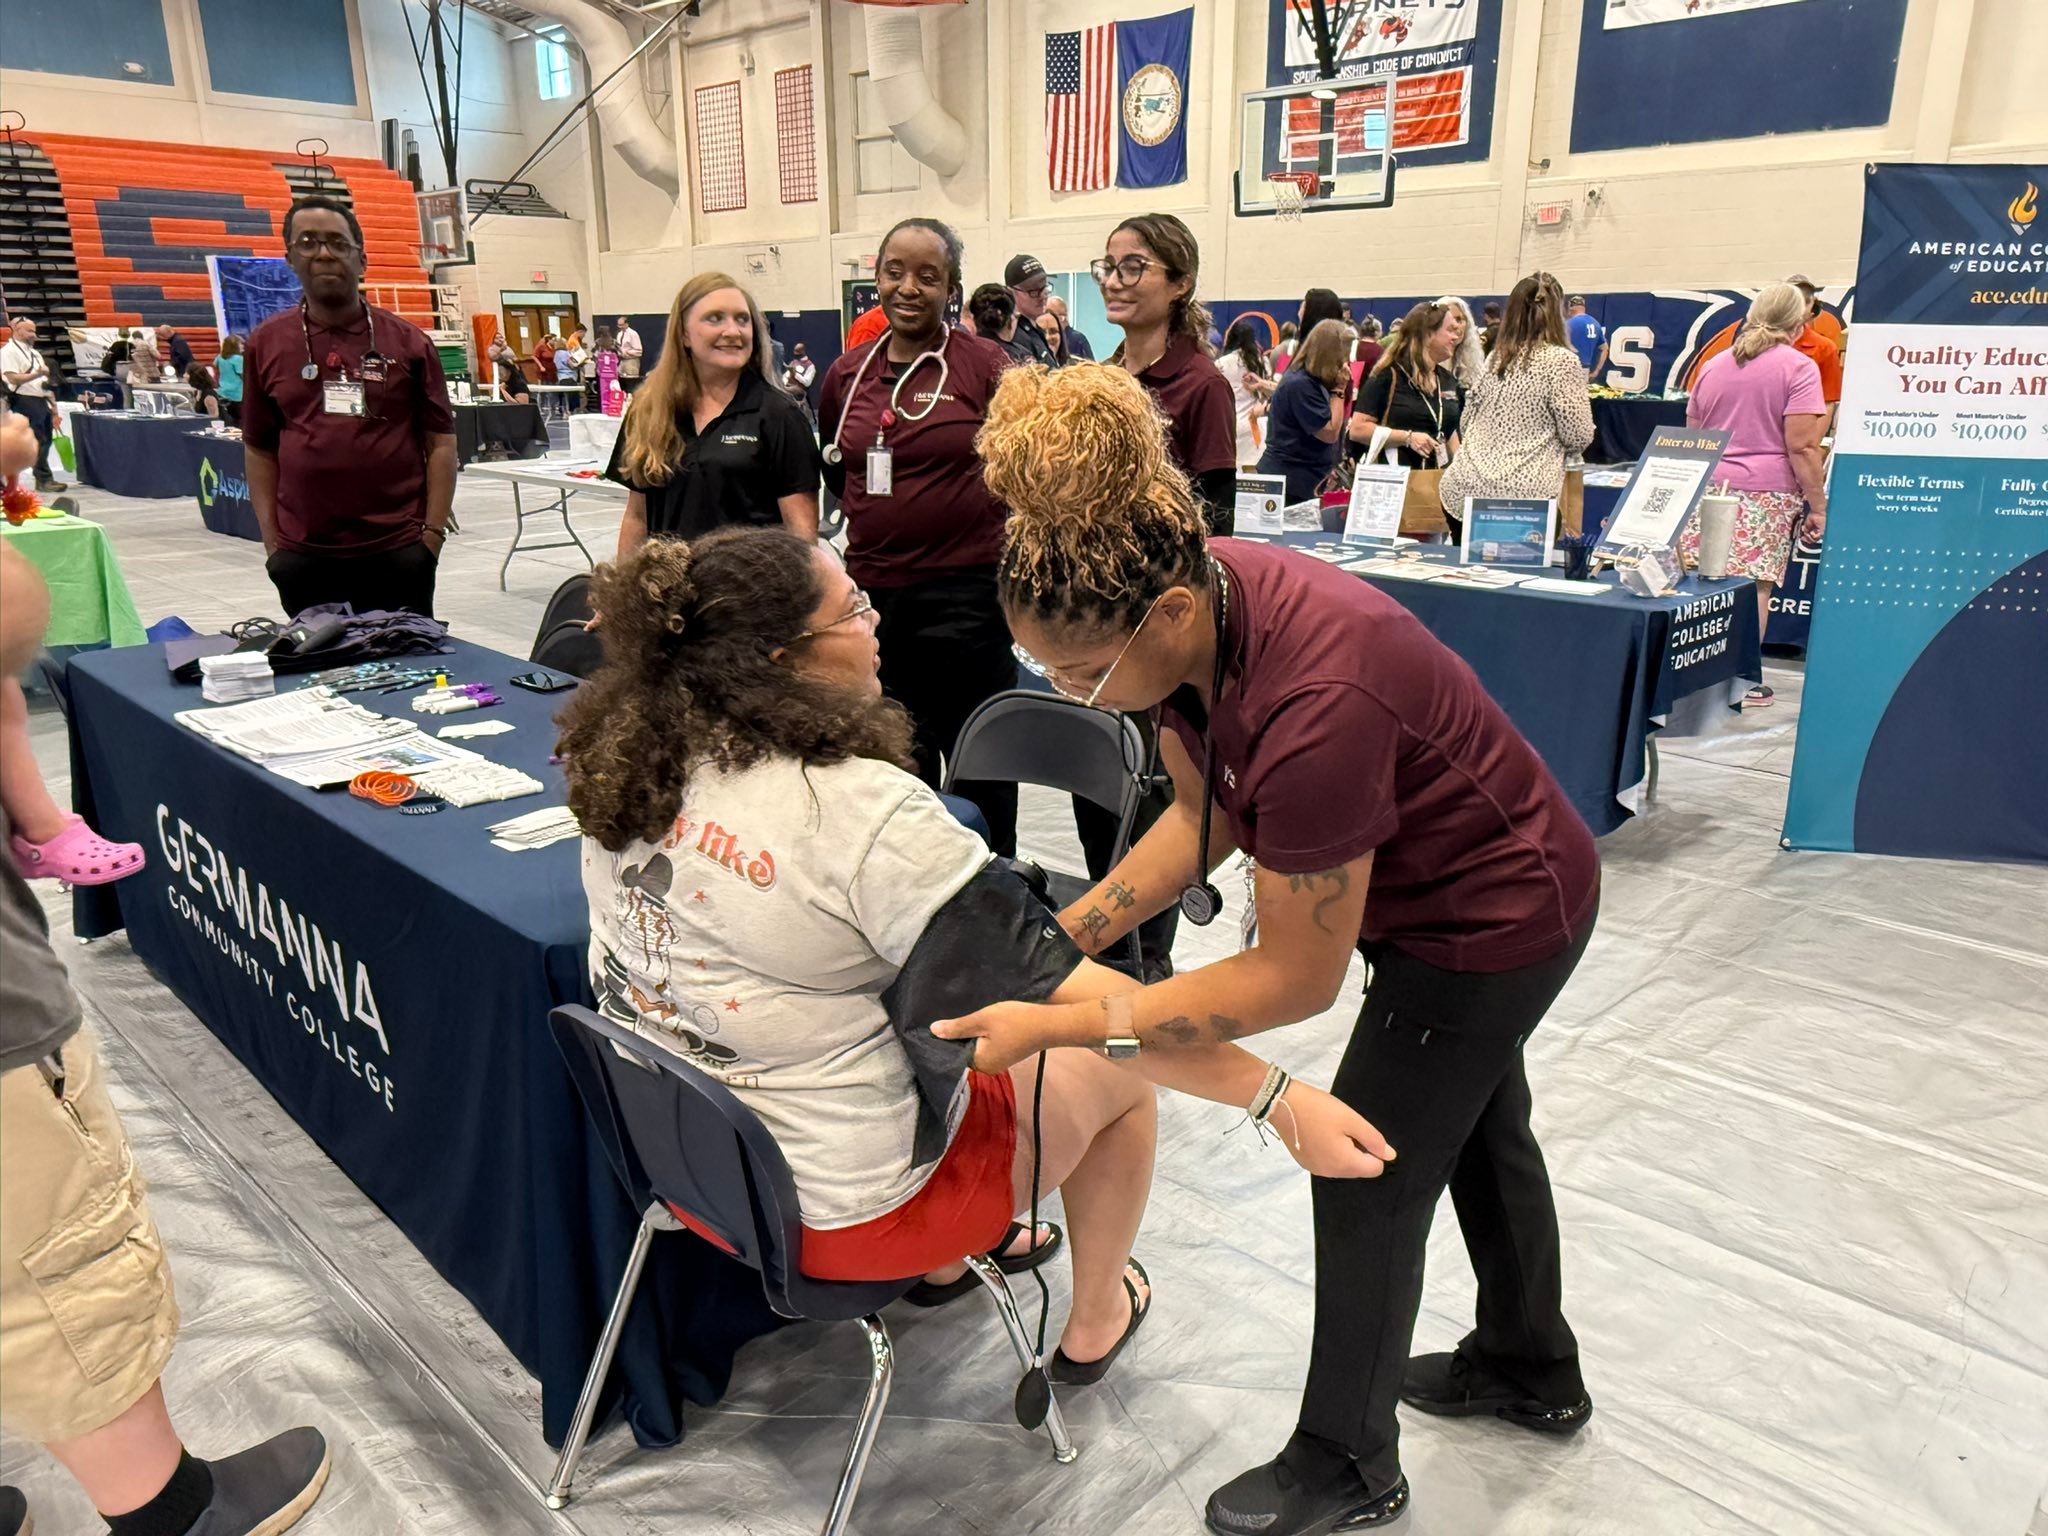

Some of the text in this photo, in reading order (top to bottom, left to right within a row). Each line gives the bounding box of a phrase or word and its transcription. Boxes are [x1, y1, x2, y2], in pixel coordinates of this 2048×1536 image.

[1372, 56, 1399, 75] CODE
[1400, 55, 1413, 70] OF
[1415, 47, 1464, 68] CONDUCT
[1909, 241, 2048, 256] AMERICAN C
[1949, 260, 1965, 273] of
[1970, 286, 2048, 304] ace.edu
[1887, 345, 2048, 371] Quality Educ
[1899, 375, 1947, 394] You
[1954, 375, 2002, 395] Can
[1862, 420, 1937, 439] $10,000
[1951, 422, 2027, 442] $10,000
[1655, 435, 1722, 451] Enter to Win!
[1857, 474, 1965, 490] Flexible Terms
[2001, 478, 2038, 495] Fully
[1875, 492, 1942, 503] New term start
[1875, 504, 1900, 514] every
[1910, 504, 1938, 513] weeks
[1994, 507, 2045, 516] Certificate
[1674, 591, 1735, 624] AMERICAN
[1671, 616, 1724, 648] COLLEGE
[695, 821, 777, 893] like
[156, 802, 390, 1056] GERMANNA
[167, 884, 394, 1113] COMMUNITY COLLEGE
